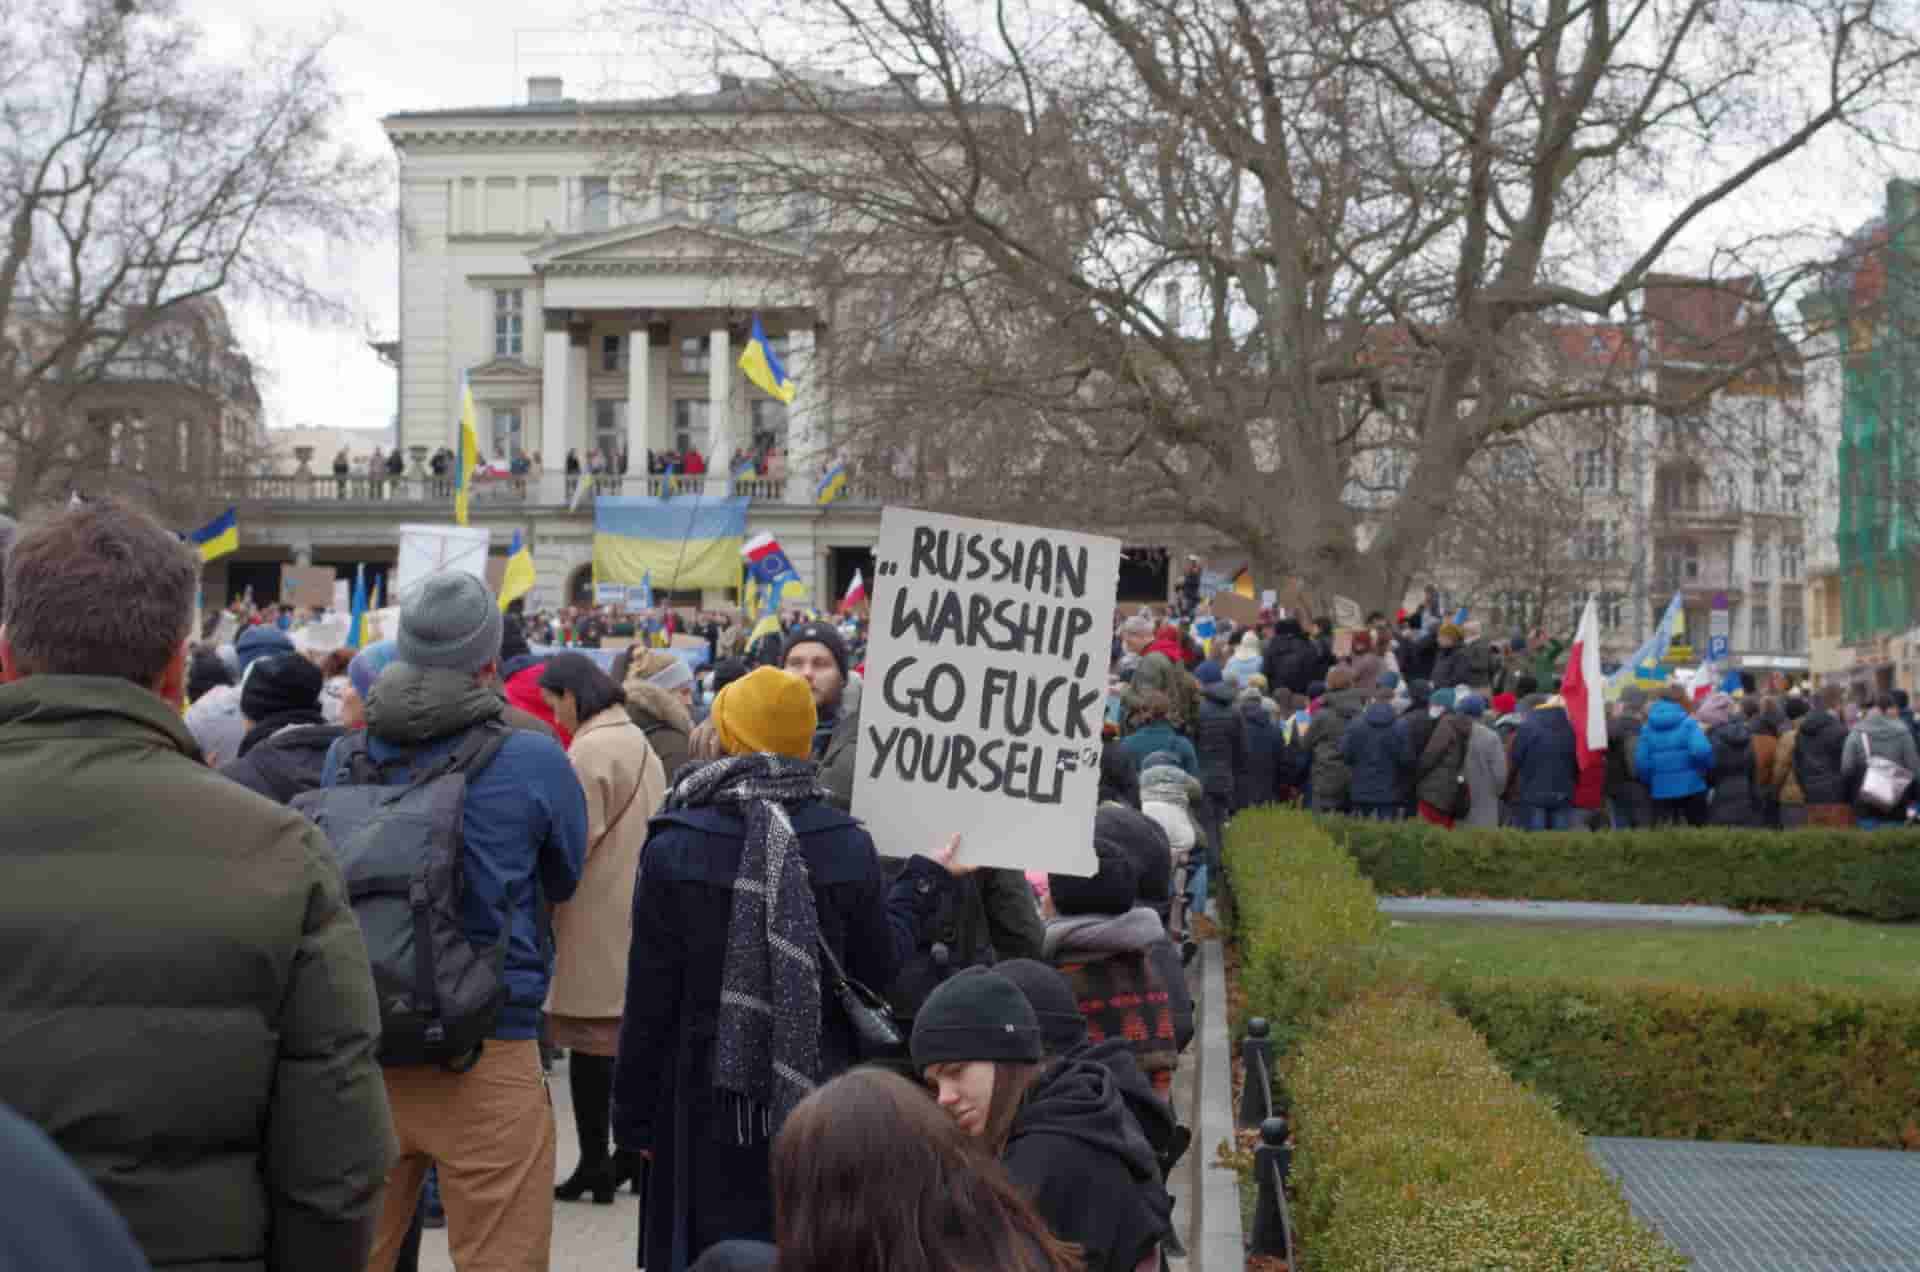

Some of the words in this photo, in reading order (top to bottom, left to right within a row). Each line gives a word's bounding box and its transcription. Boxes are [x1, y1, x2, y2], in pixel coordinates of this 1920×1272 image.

[890, 587, 1093, 678] WARSHIP,
[883, 656, 966, 722] GO
[979, 667, 1099, 739] FUCK
